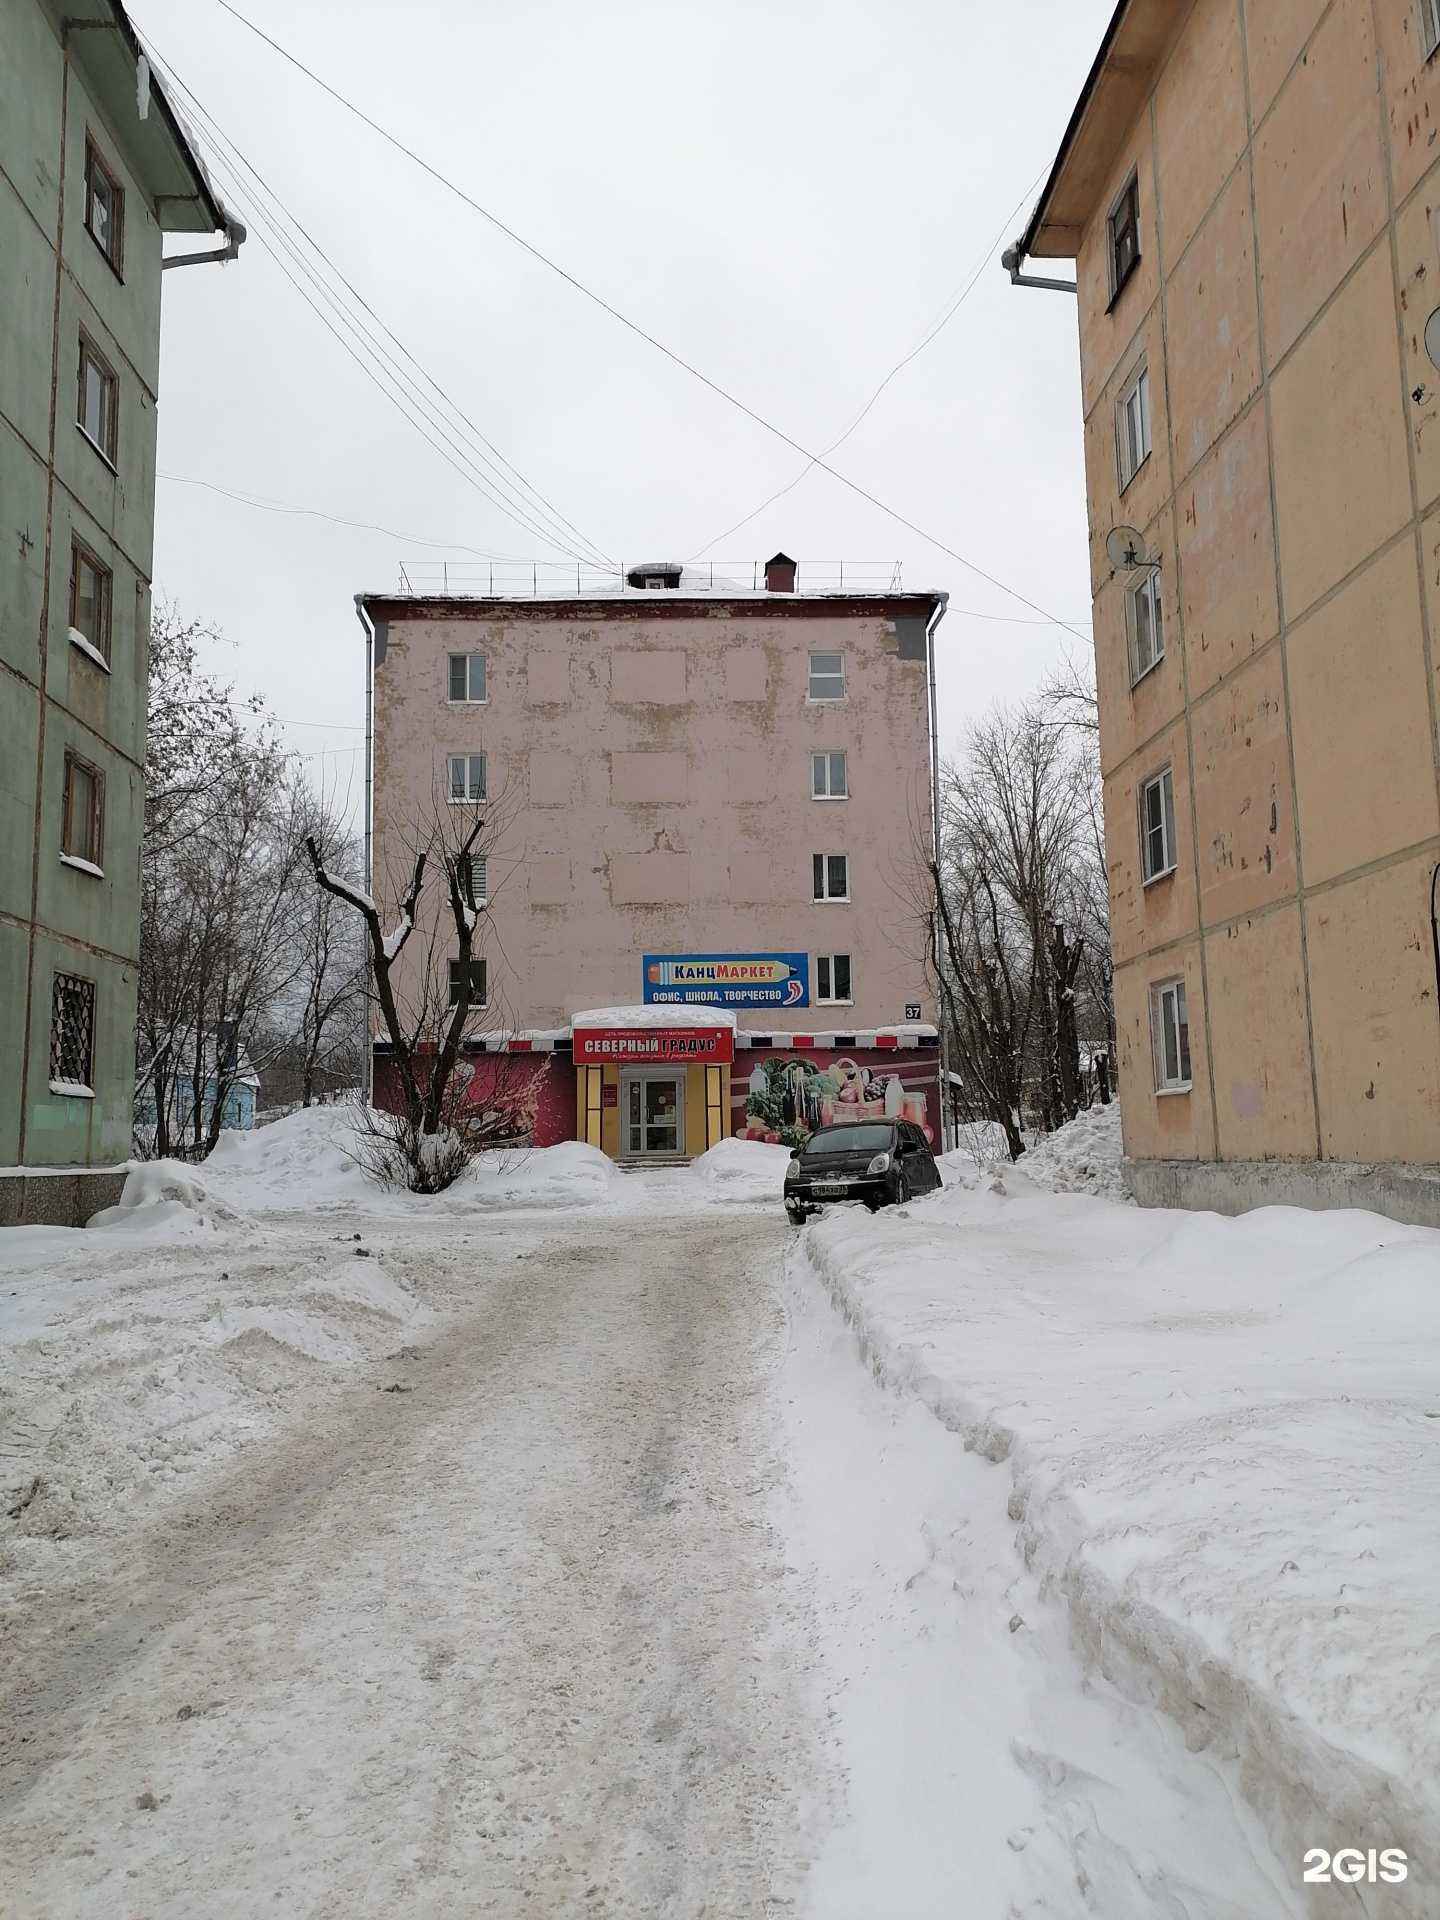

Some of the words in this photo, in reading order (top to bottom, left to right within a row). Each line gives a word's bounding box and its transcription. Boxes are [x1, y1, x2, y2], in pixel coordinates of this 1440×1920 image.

[653, 991, 683, 1003] ОФИС,
[685, 991, 723, 1002] ШКОЛА,
[724, 990, 782, 1001] ТВОРЧЕСТВО
[906, 1007, 920, 1018] 37
[584, 1037, 659, 1053] СЕВЕРНЫЙ
[661, 1038, 716, 1054] ГРАДУС
